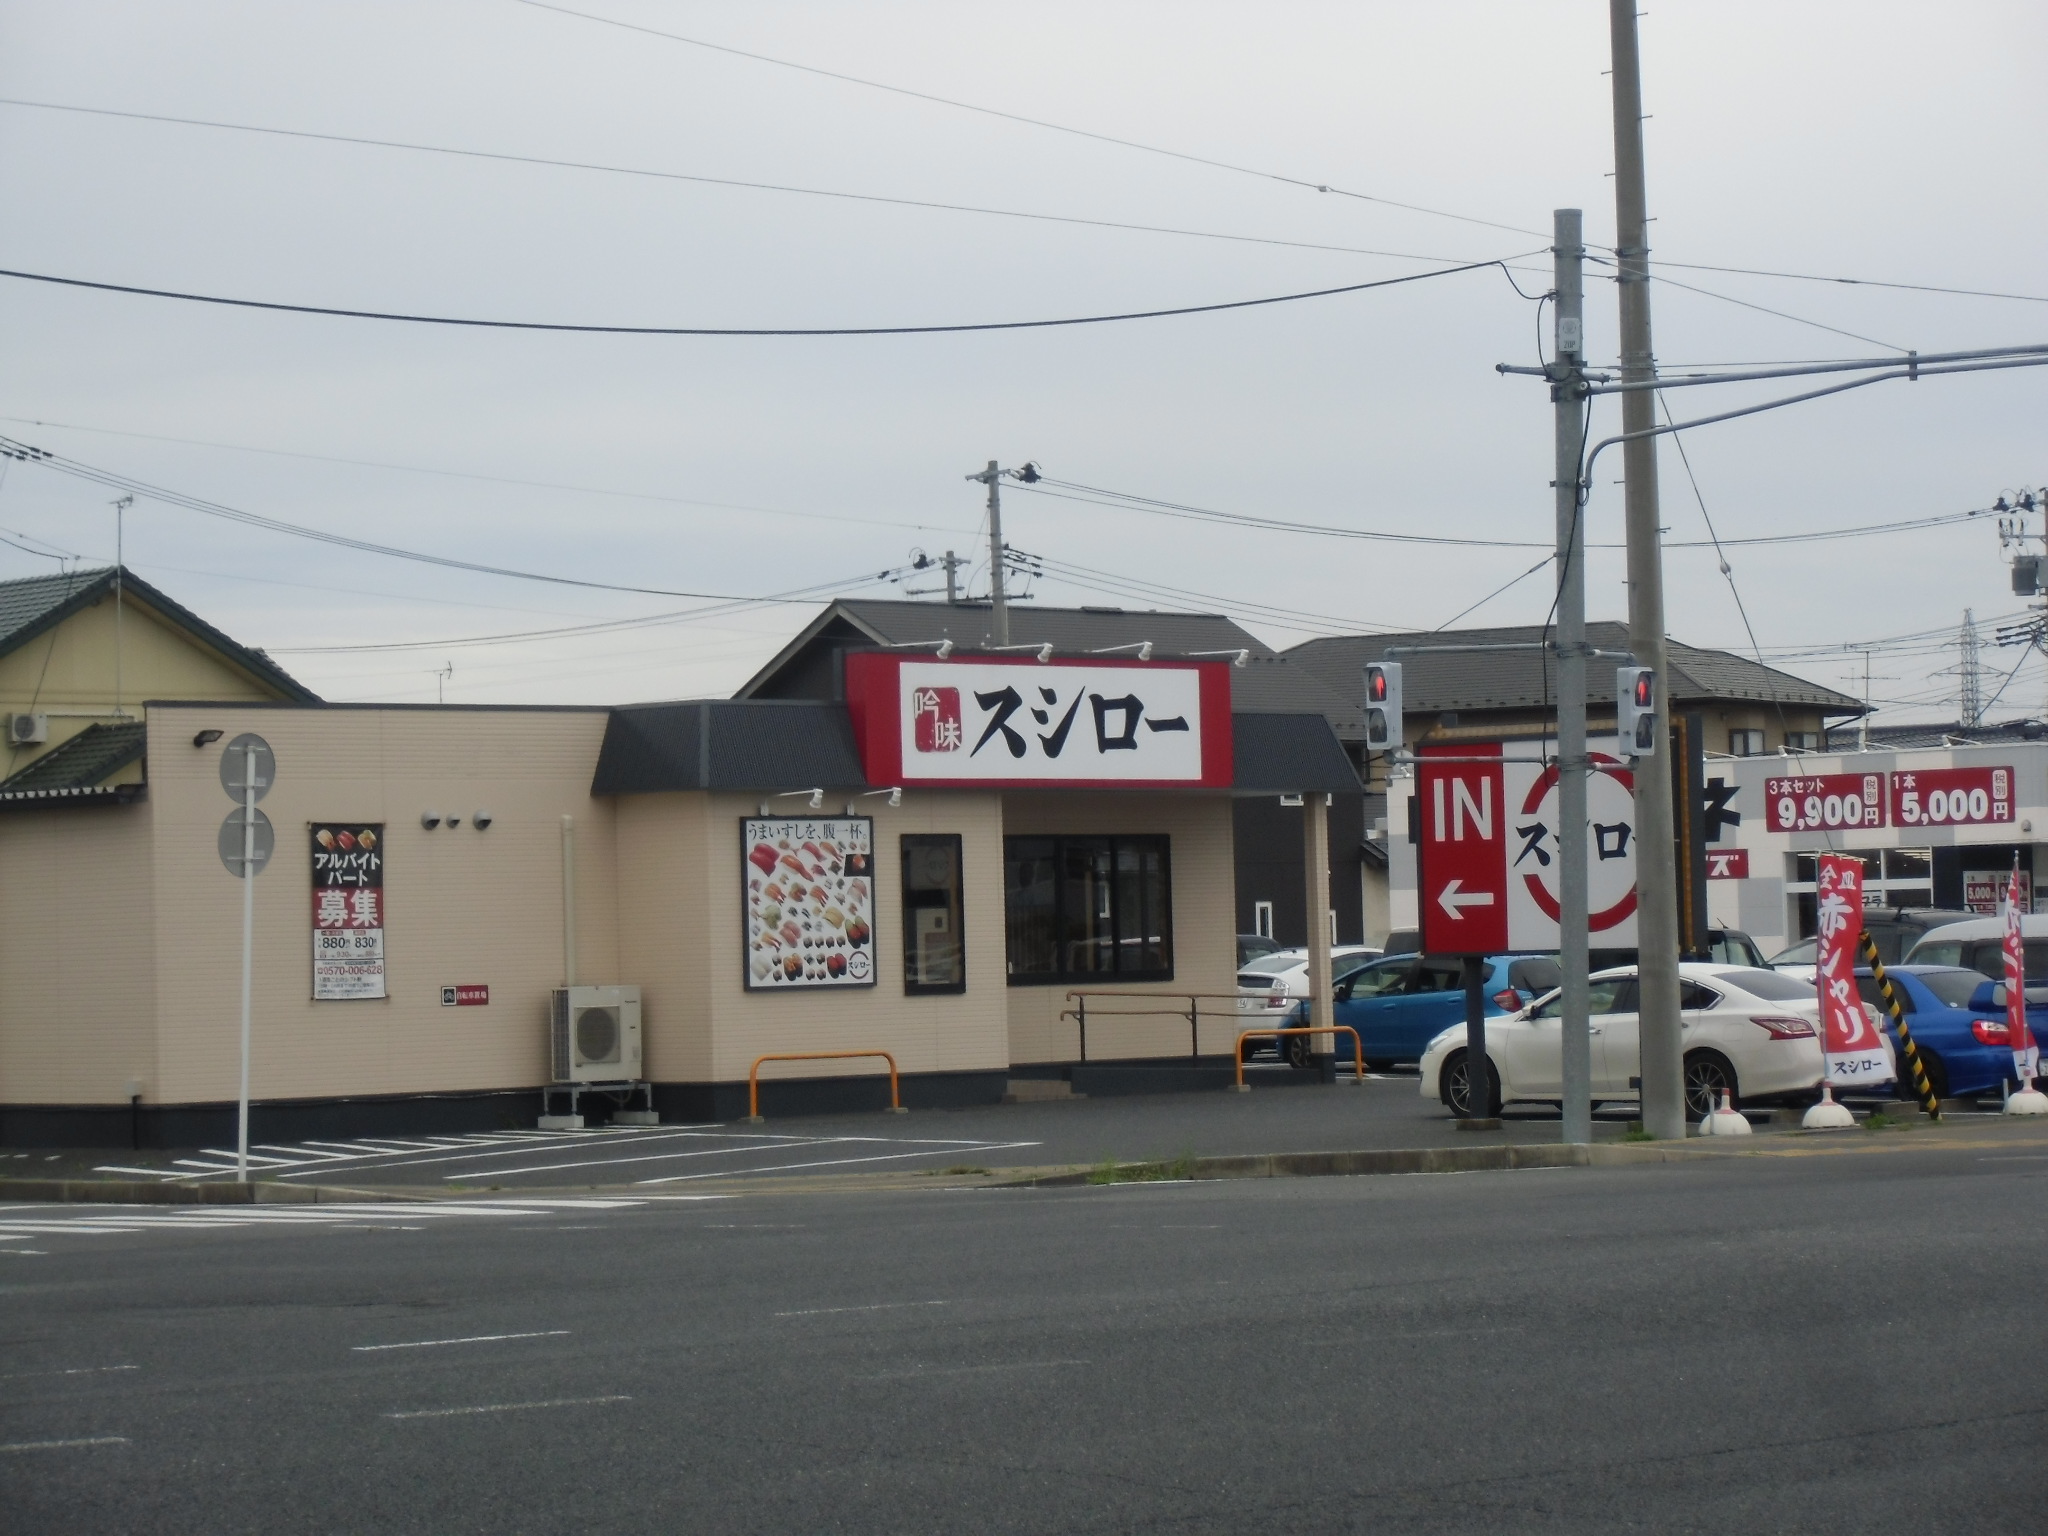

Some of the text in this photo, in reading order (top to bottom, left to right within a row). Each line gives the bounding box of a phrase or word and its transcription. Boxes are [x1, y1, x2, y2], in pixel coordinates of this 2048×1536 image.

[914, 685, 1190, 759] 吟味 スシロー
[1769, 778, 1824, 795] 3本セット
[1433, 776, 1493, 842] IN
[749, 823, 867, 840] うまいすしを、腹一杯。
[1513, 820, 1636, 868] スロ
[314, 853, 381, 870] アルバイト
[1706, 855, 1740, 877] ズ
[328, 870, 368, 886] パート
[318, 890, 379, 927] 募集
[1818, 892, 1865, 1044] 赤シャリ
[1834, 1059, 1883, 1075] スシロー
